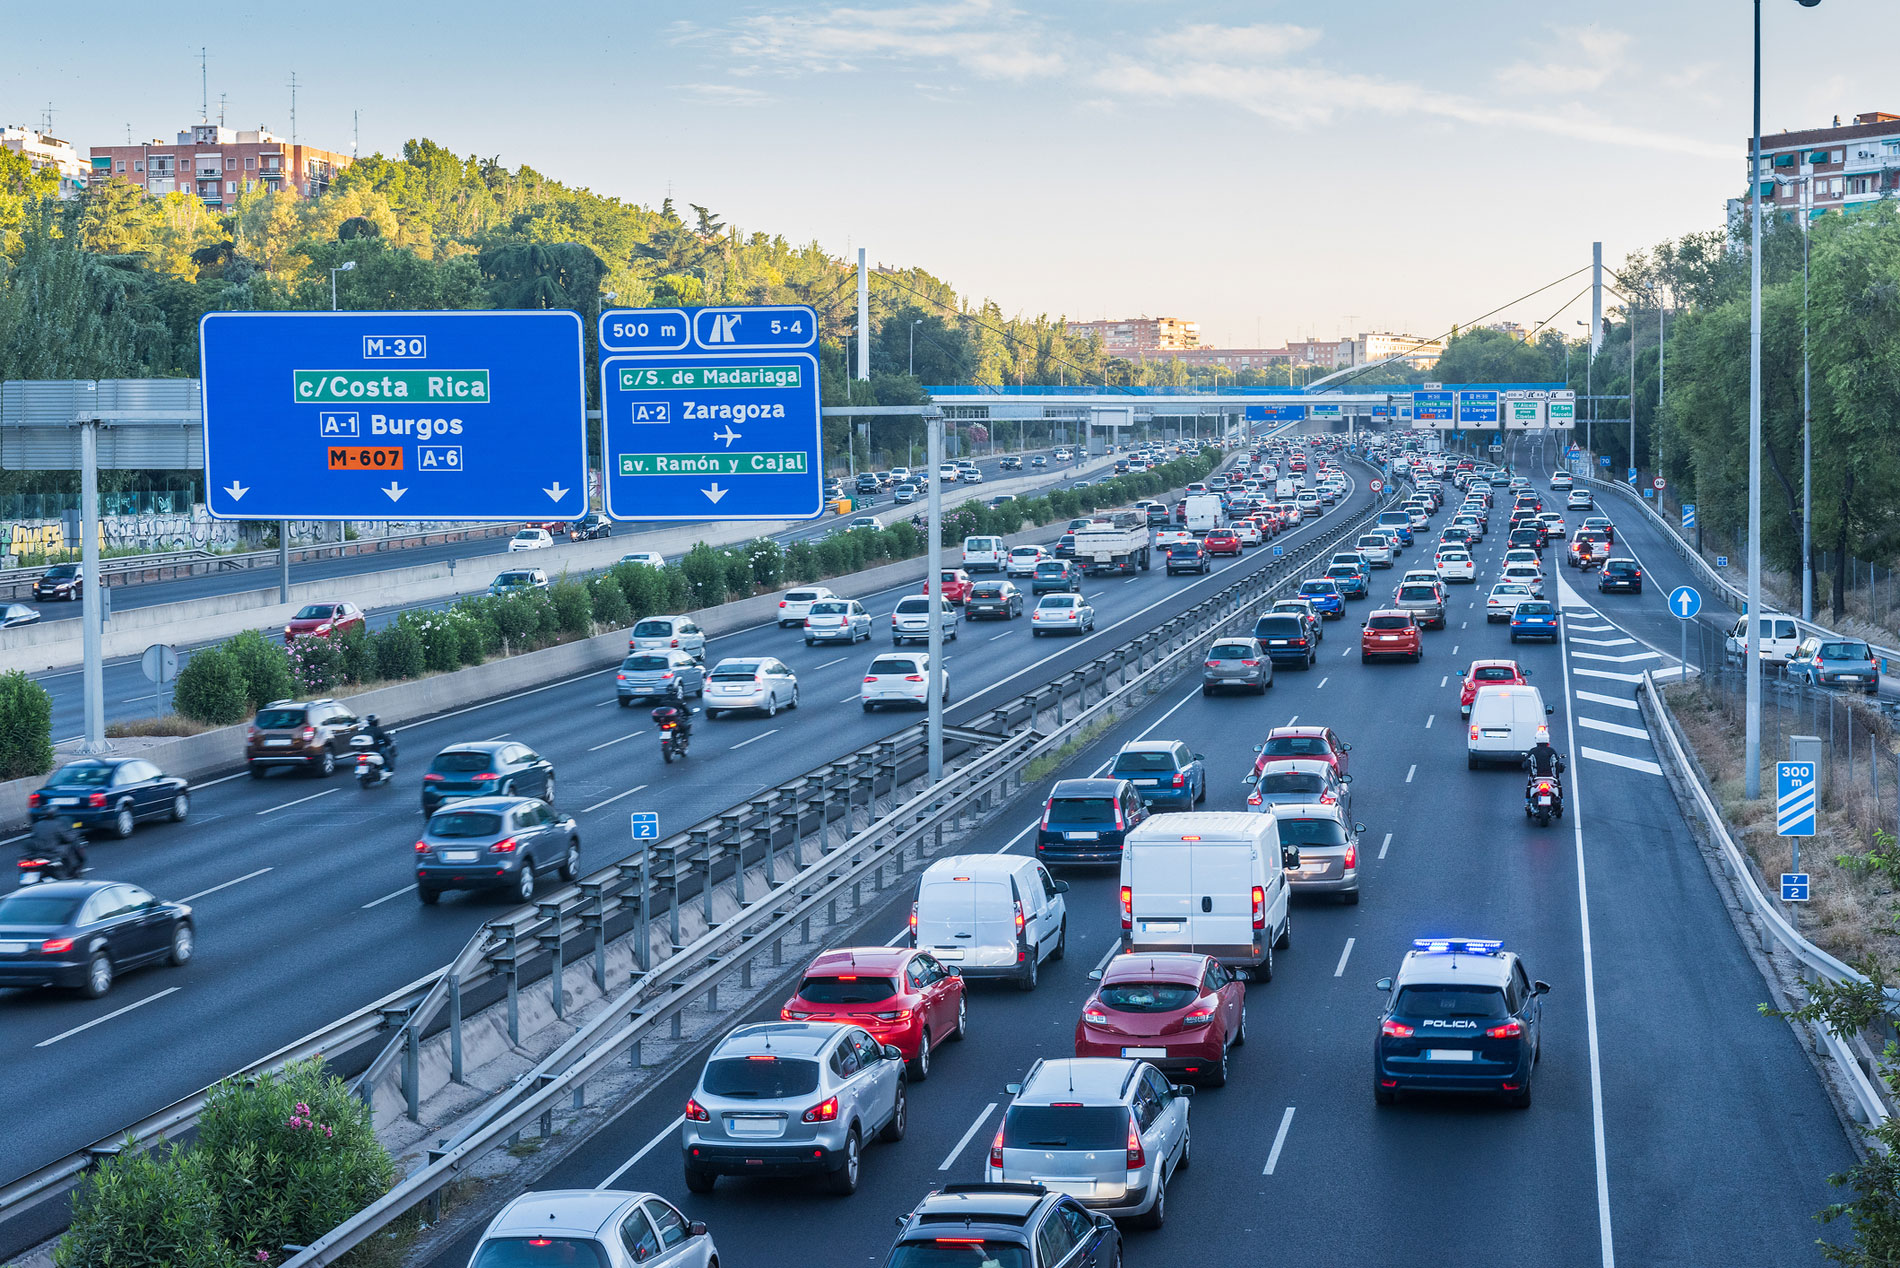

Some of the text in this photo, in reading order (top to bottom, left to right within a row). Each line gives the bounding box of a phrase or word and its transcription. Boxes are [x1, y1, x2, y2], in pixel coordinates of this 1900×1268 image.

[613, 324, 676, 337] 500 m
[770, 320, 803, 335] 5-4
[367, 340, 422, 355] M-30
[672, 371, 695, 384] de
[703, 369, 798, 387] Madariaga
[299, 376, 486, 397] c/Costa Rica
[636, 402, 785, 423] A-2 Zaragoza
[324, 415, 463, 440] A-1 Burgos
[331, 450, 458, 466] M-607 A-6
[623, 455, 803, 473] av. Ramón y Cajal
[1782, 766, 1810, 778] 300
[1791, 779, 1802, 787] m
[641, 825, 650, 836] 2
[1790, 888, 1800, 898] 2
